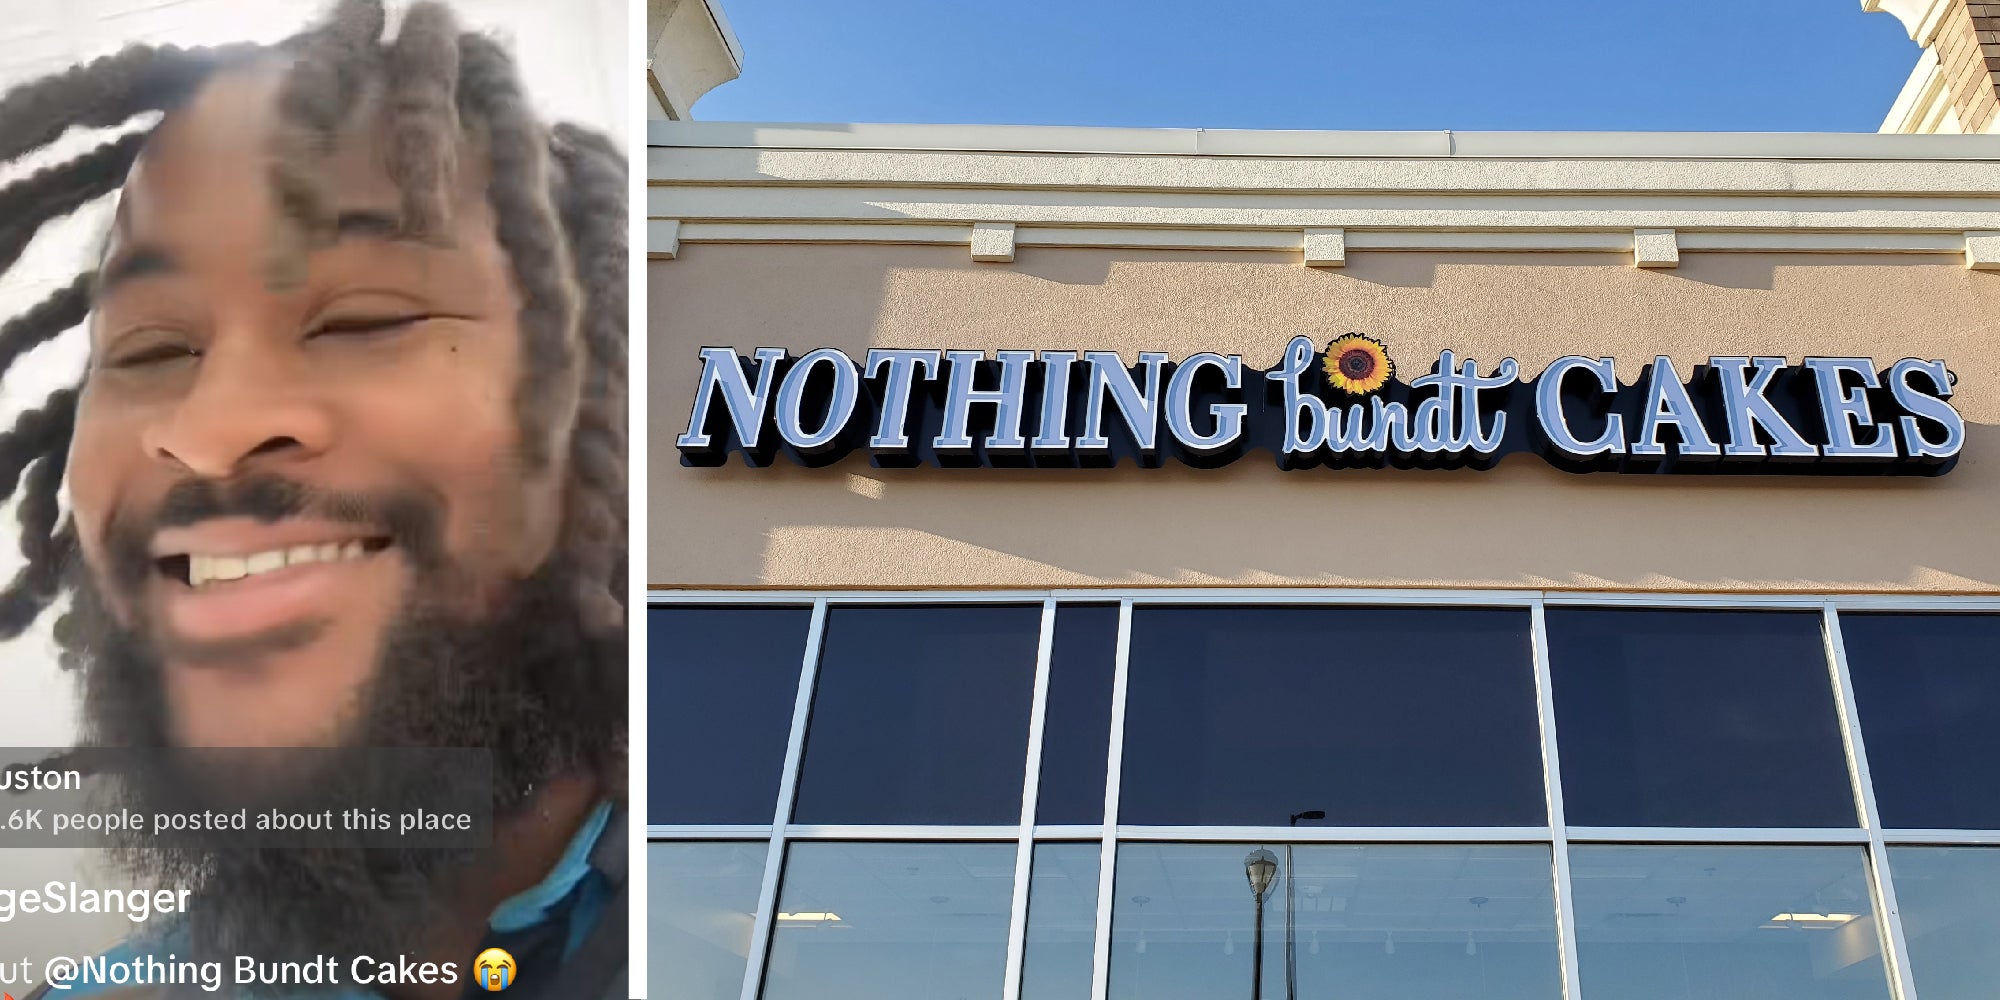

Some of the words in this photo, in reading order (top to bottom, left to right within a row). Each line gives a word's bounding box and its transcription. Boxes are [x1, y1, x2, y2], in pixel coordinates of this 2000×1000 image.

[676, 346, 1248, 450] NOTHING
[1265, 334, 1519, 453] bundt
[1535, 355, 1966, 458] CAKES
